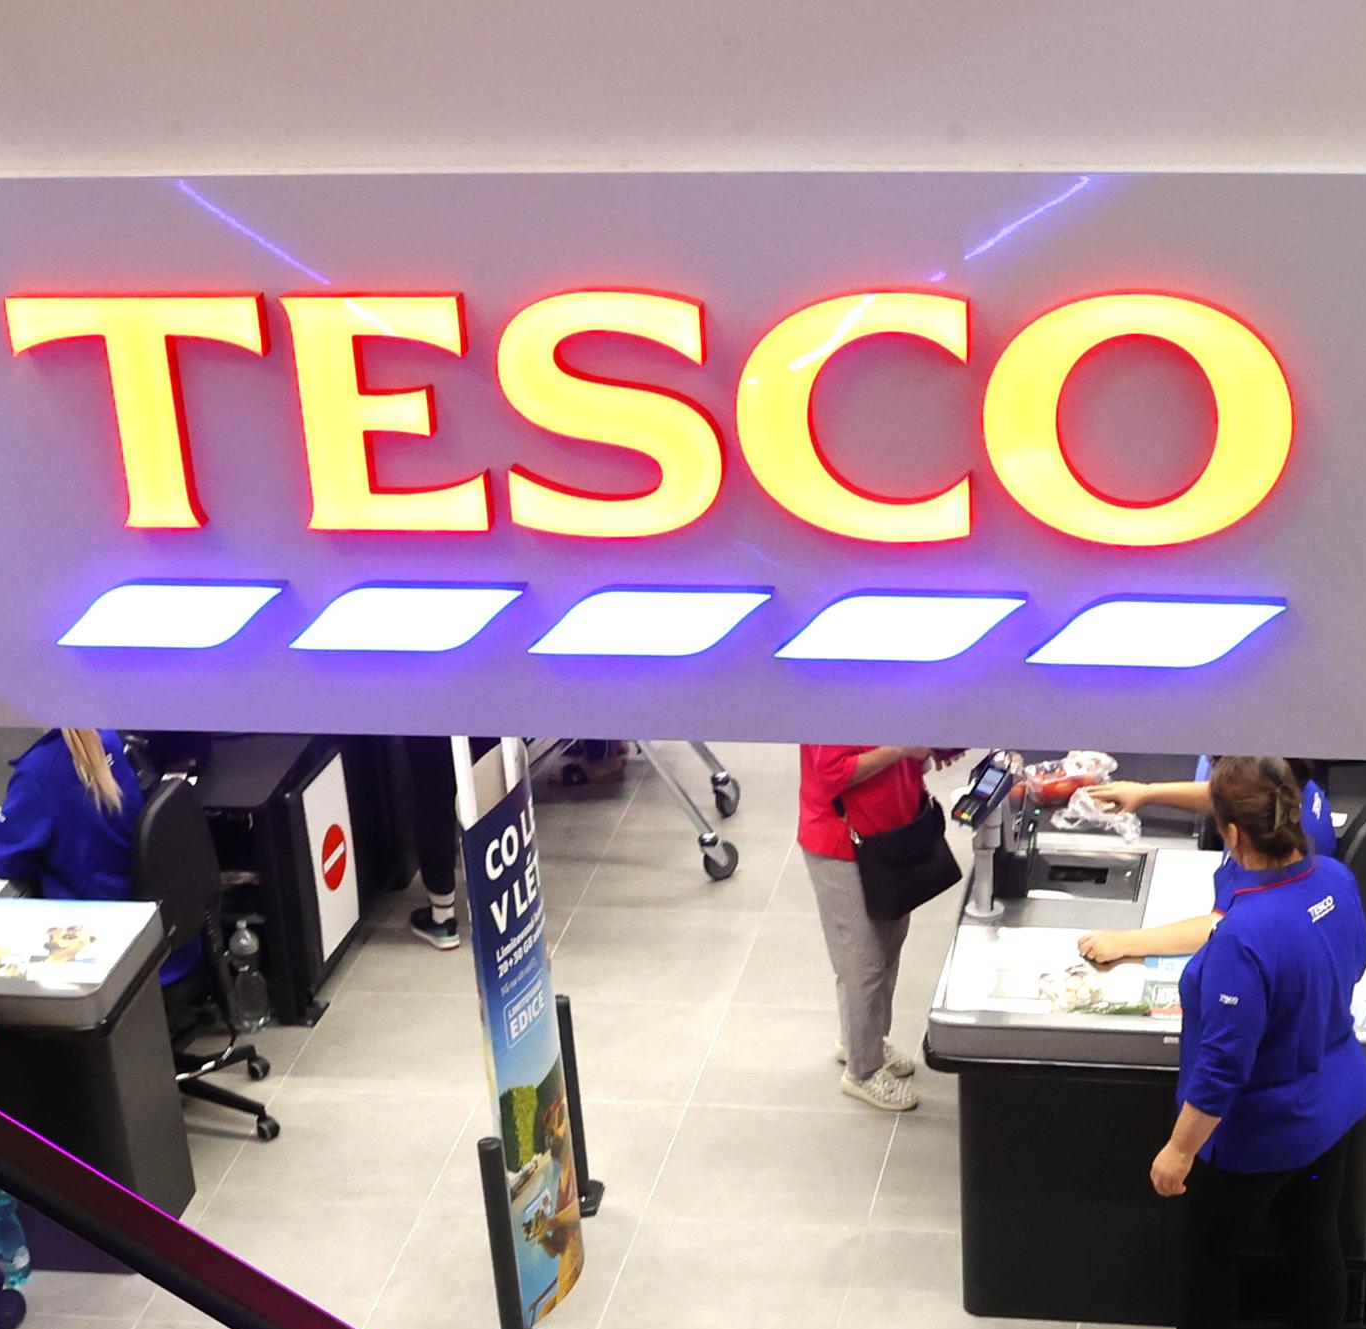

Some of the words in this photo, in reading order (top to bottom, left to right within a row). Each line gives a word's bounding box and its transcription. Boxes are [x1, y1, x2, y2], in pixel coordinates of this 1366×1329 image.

[5, 289, 1295, 548] TESCO
[485, 824, 519, 881] CO
[490, 889, 509, 935] V
[1307, 895, 1334, 918] TESCO
[510, 990, 546, 1040] EDICE
